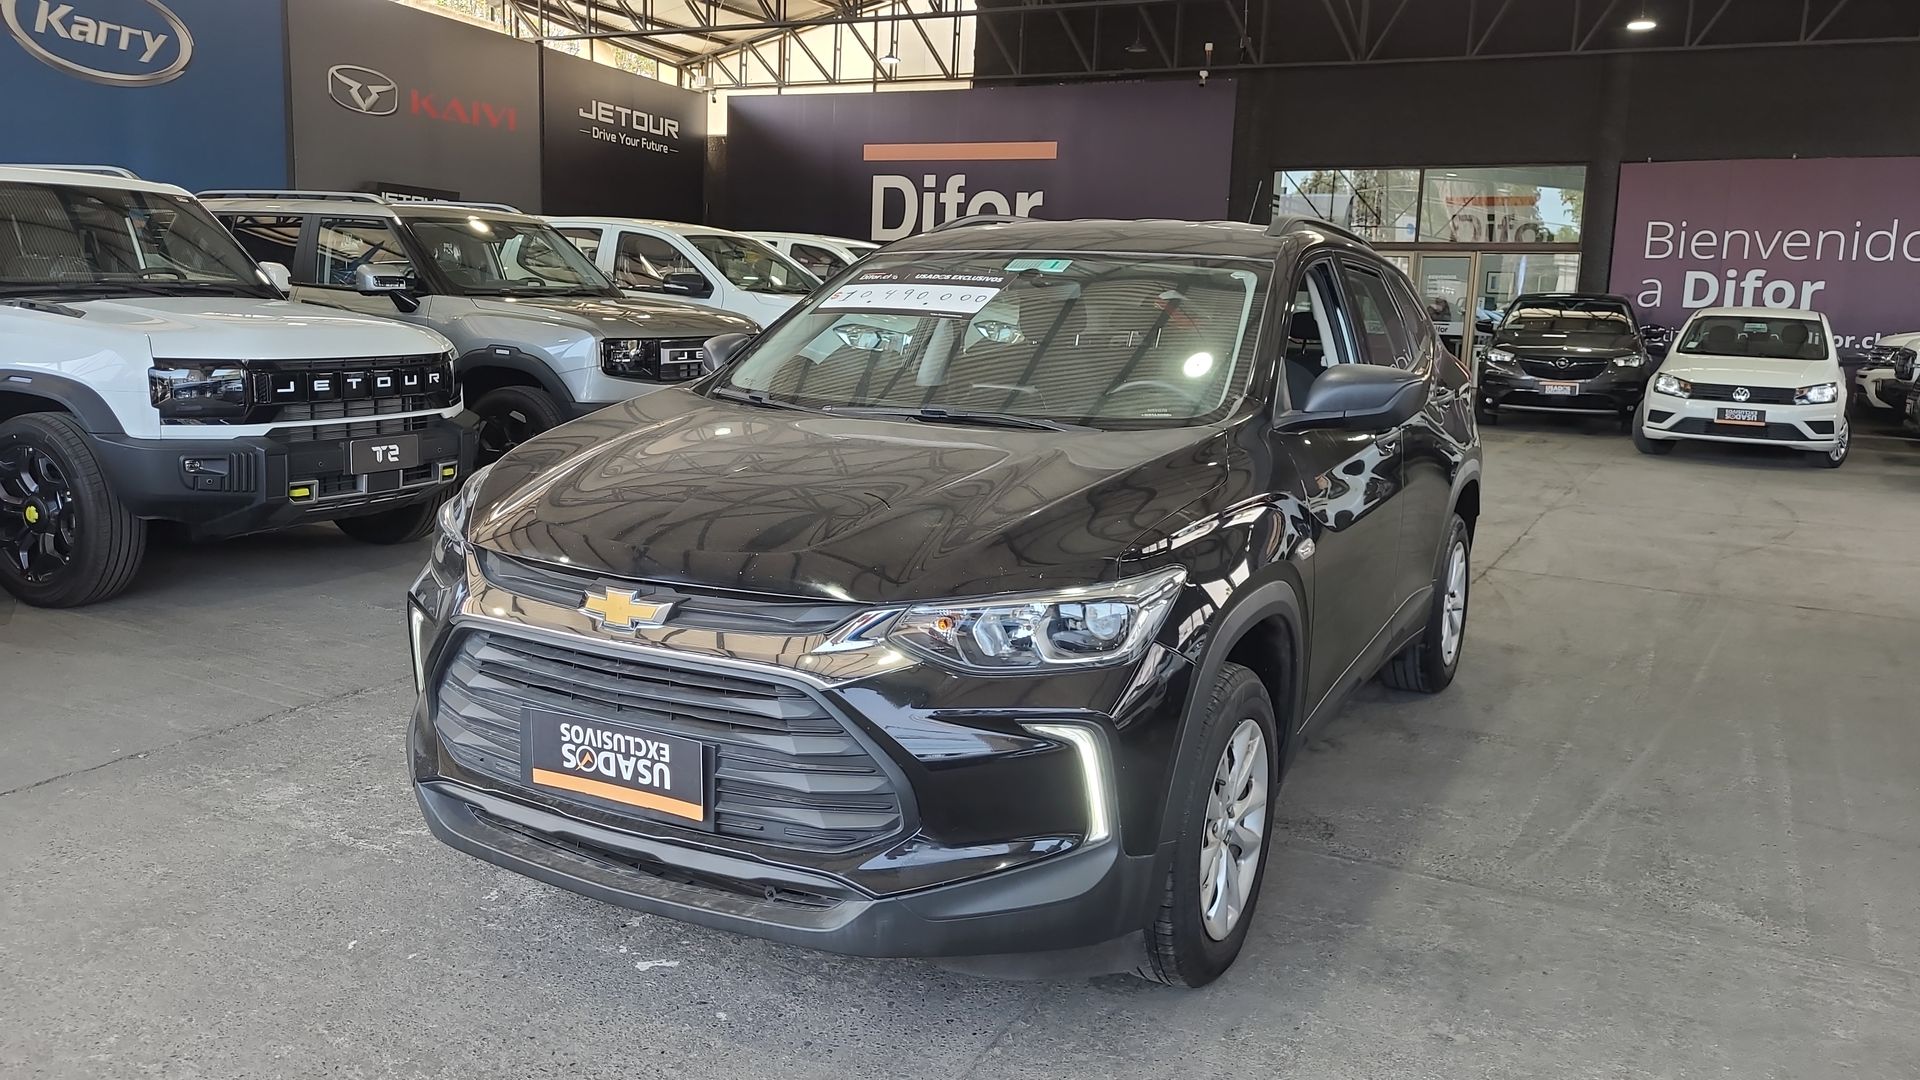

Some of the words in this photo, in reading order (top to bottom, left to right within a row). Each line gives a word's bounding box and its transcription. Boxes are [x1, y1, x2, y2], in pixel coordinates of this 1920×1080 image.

[34, 0, 168, 63] Karry
[578, 99, 679, 140] JETOUR
[592, 126, 617, 143] Drive
[618, 132, 640, 148] Your
[641, 137, 669, 154] Future
[914, 273, 950, 281] USADOS
[950, 274, 1004, 283] EXCLUSIVOS
[1637, 277, 1664, 309] a
[1681, 268, 1826, 311] Difor
[276, 372, 440, 393] JETOUR
[371, 444, 401, 463] T2
[560, 722, 670, 763] EXCLUSIVOS
[561, 743, 671, 790] USADOS
